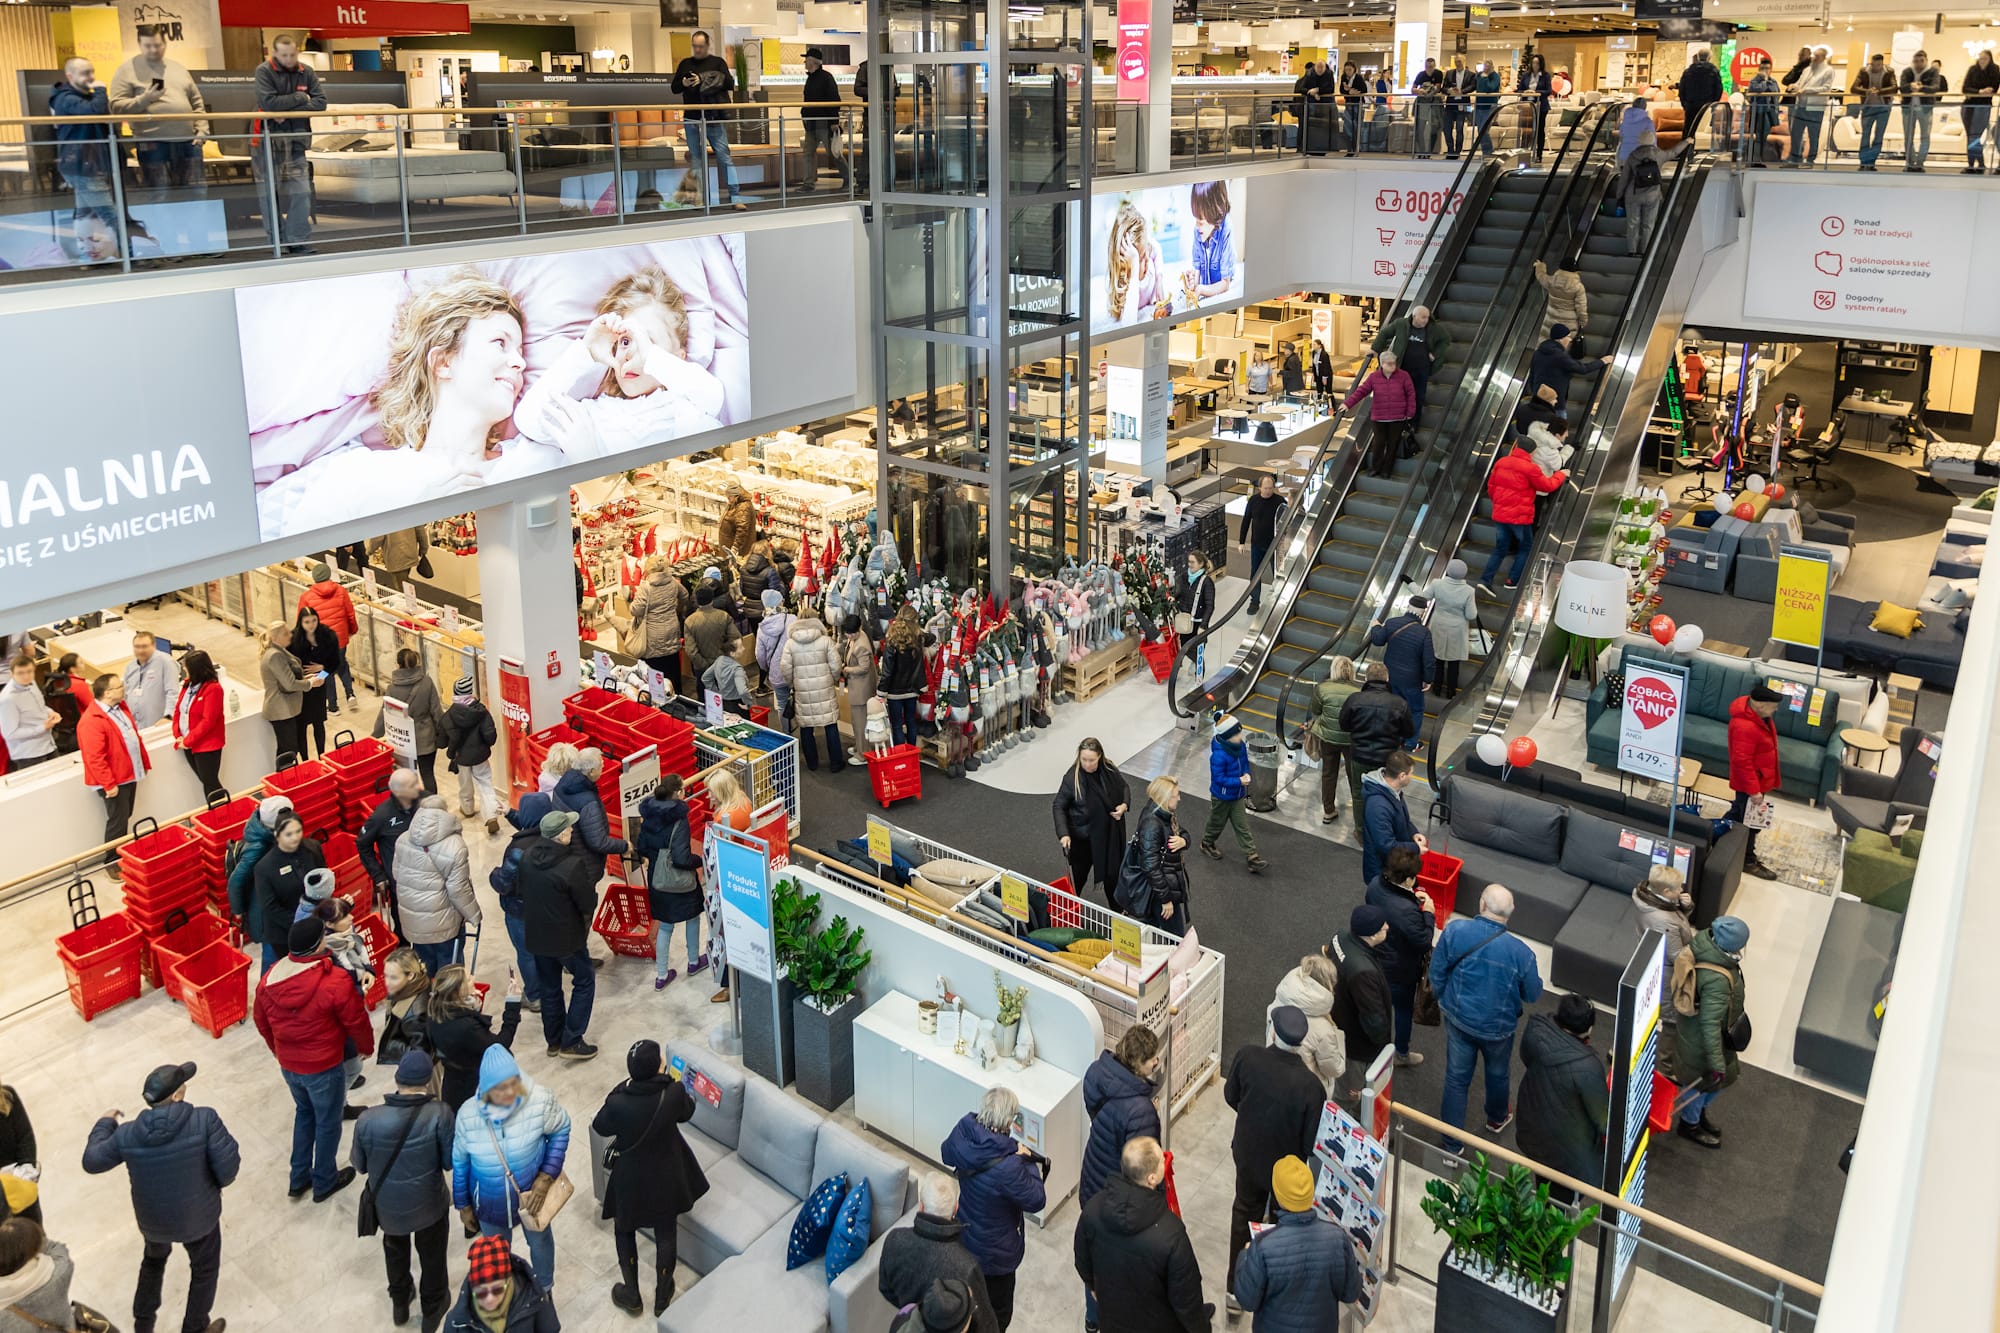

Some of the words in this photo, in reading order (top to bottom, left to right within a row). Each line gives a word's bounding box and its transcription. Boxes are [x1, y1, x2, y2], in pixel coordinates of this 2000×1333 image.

[337, 5, 367, 24] hit
[1853, 219, 1881, 227] Ponad
[1853, 228, 1864, 236] 70
[1879, 230, 1912, 239] tradycji
[1849, 256, 1911, 267] Ogólnopolska
[1848, 266, 1885, 275] salonów
[1887, 268, 1931, 278] sprzedaży
[1845, 293, 1884, 304] Dogodny
[1844, 303, 1875, 312] system
[1876, 303, 1907, 315] ratalny
[38, 537, 56, 559] Z
[62, 501, 216, 552] UŚMIECHEM
[1779, 586, 1822, 602] NIŻSZA
[1783, 599, 1815, 612] CENA
[1630, 684, 1675, 703] ZOBACZ
[1627, 749, 1633, 759] 1
[727, 871, 758, 889] Produkt
[727, 881, 732, 889] z
[732, 883, 761, 900] gazetki
